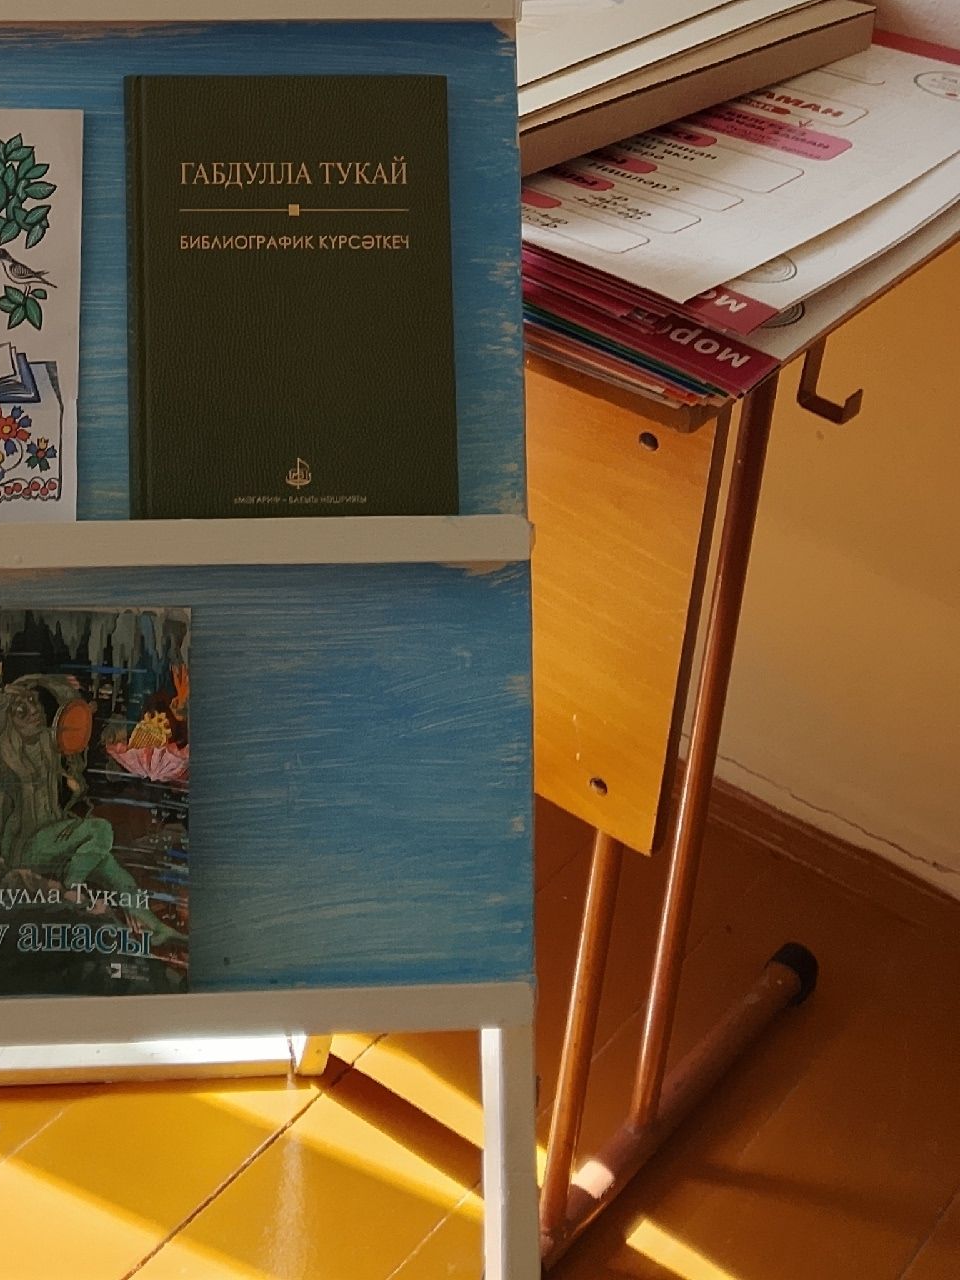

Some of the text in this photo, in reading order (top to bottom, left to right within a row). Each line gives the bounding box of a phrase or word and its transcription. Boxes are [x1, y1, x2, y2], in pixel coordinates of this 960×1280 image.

[179, 155, 408, 190] ГАБДУЛЛА ТУКАЙ
[179, 234, 410, 250] БИБЛИОГРАФИК КҮРСӘТКЕЧ
[70, 882, 150, 911] Тукай
[16, 922, 154, 958] анасы
